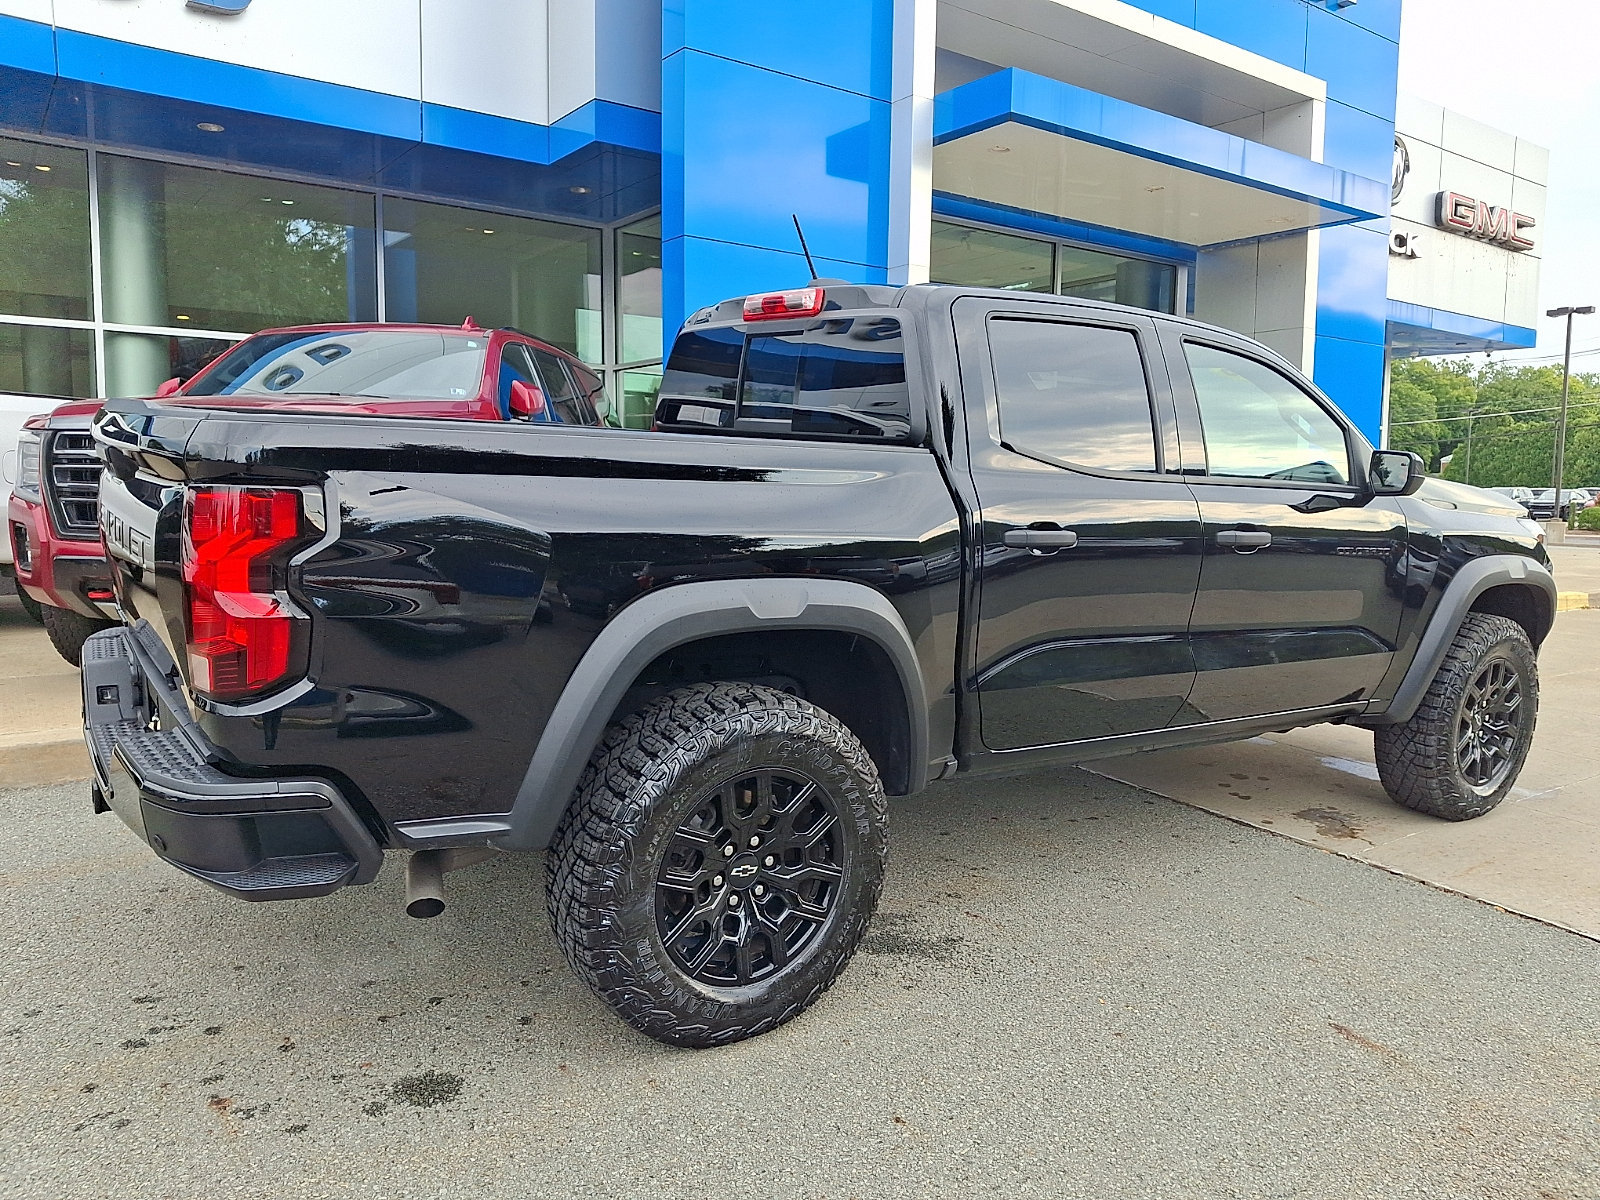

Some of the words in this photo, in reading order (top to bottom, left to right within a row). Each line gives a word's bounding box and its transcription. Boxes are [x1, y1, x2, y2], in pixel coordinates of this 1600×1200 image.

[1447, 191, 1535, 248] GMC
[777, 739, 870, 836] GOODYEAR
[636, 936, 738, 1020] WRANGLER
